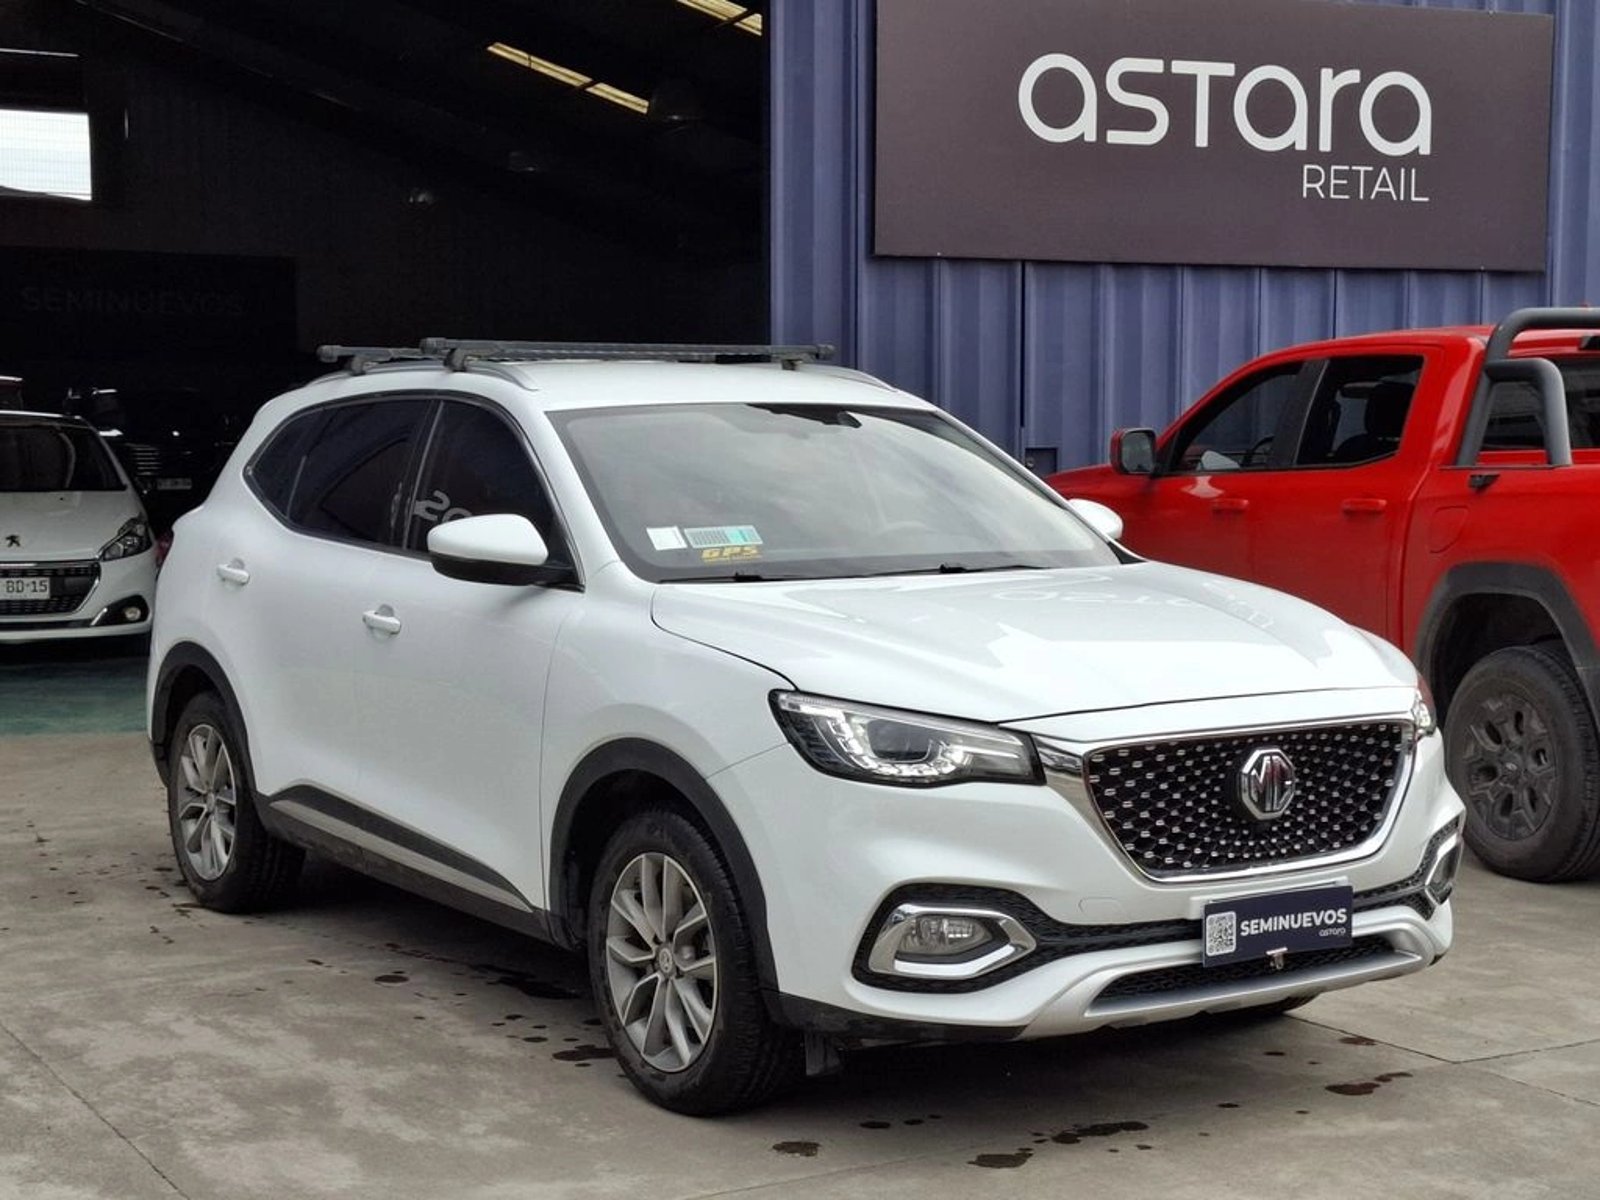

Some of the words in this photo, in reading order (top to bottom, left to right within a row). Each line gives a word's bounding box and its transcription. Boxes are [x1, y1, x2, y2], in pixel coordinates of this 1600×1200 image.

[1018, 53, 1432, 156] astara
[1301, 164, 1430, 202] RETAIL
[20, 286, 245, 315] SEMINUEVOS
[1240, 908, 1347, 936] SEMINUEVOS
